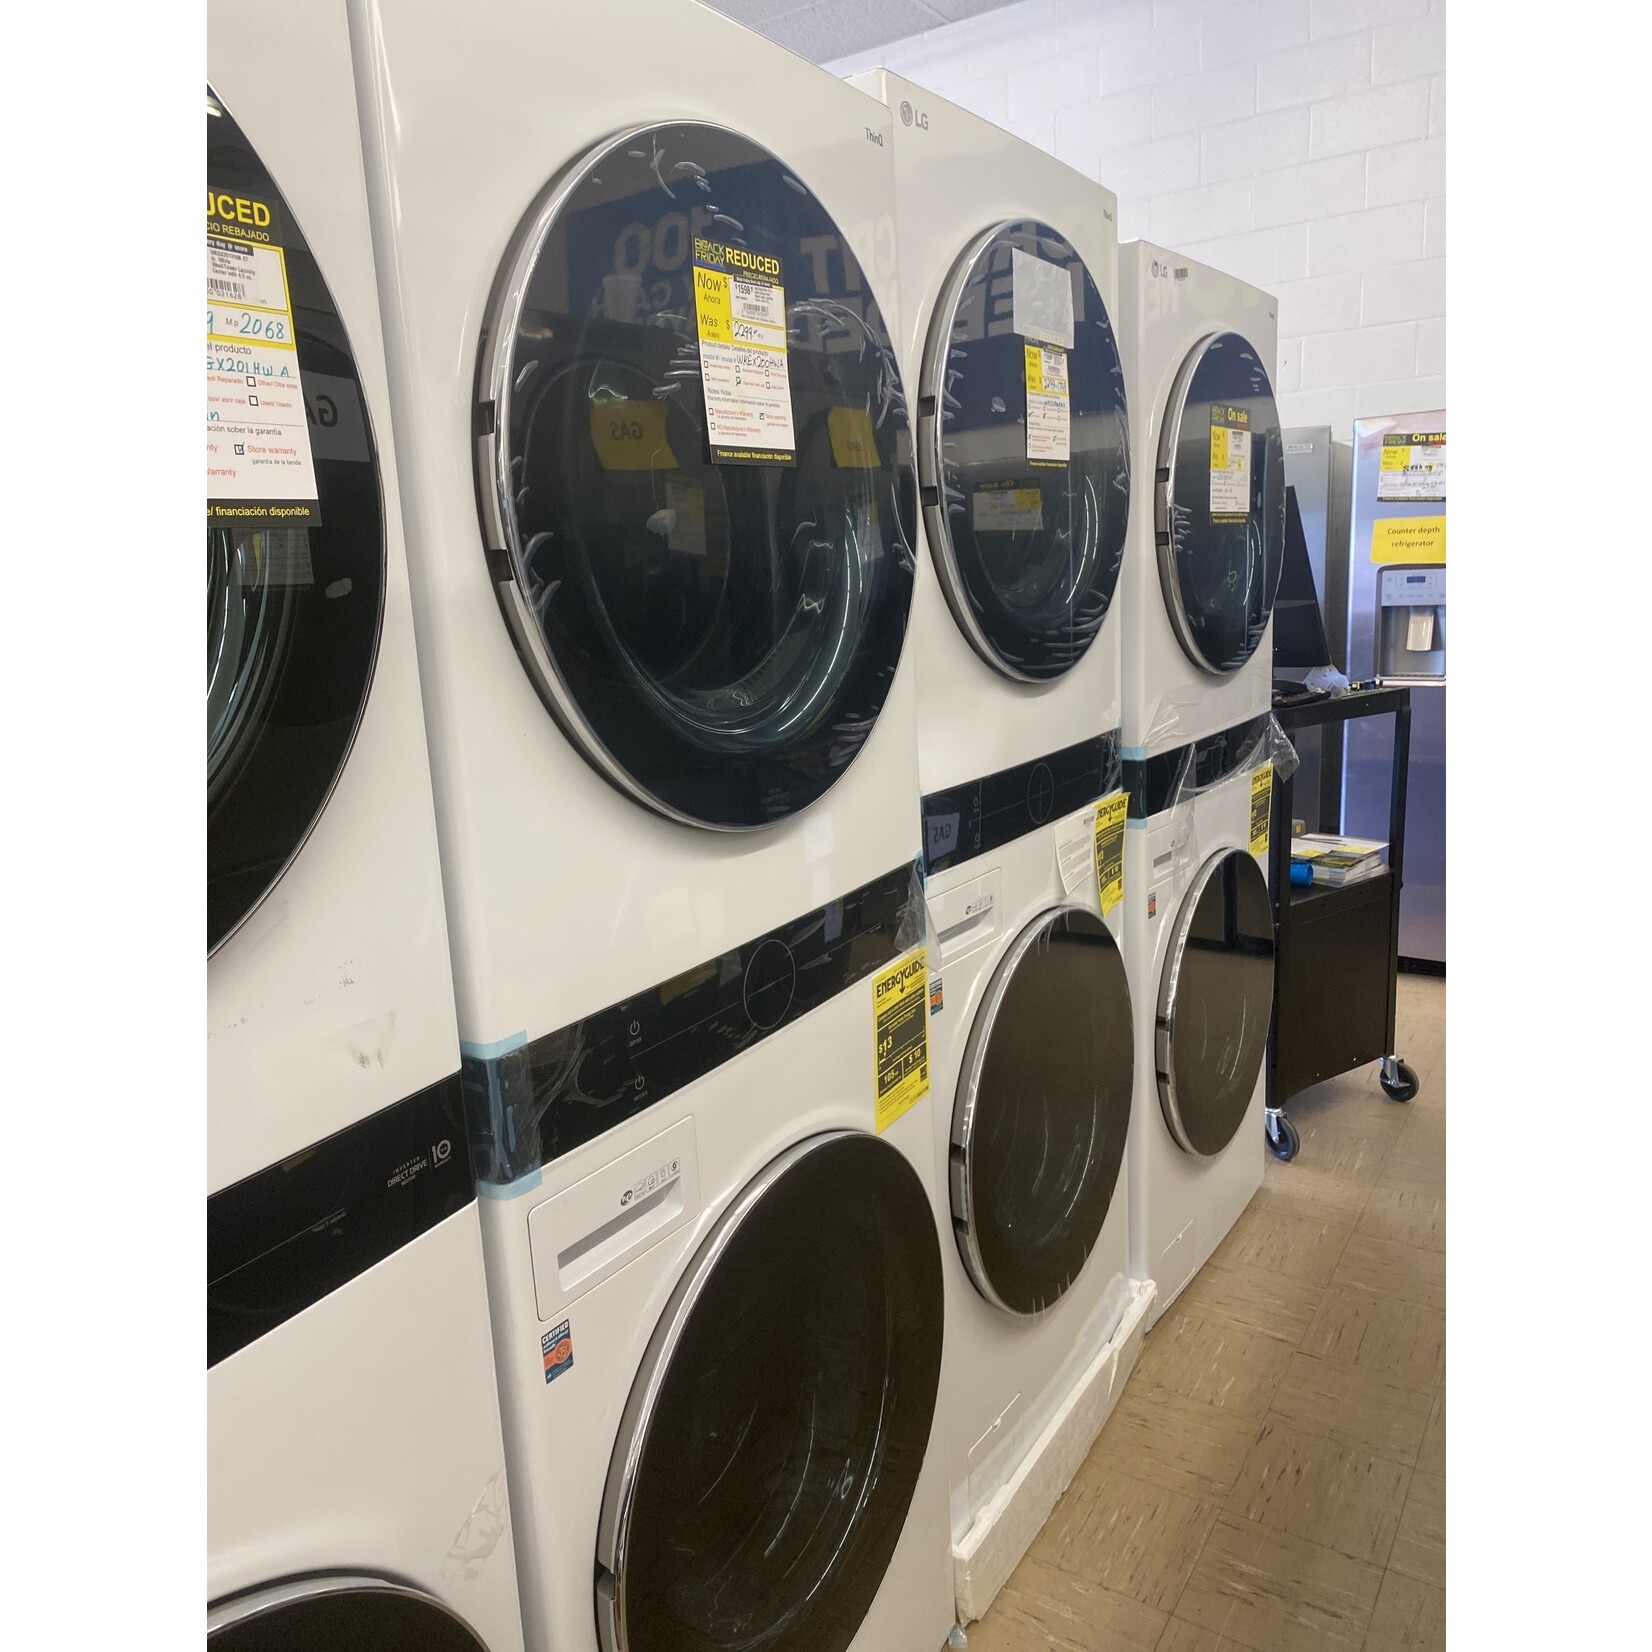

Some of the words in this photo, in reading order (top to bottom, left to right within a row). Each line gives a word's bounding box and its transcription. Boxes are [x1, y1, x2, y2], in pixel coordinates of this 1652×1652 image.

[914, 109, 929, 131] LG
[865, 126, 884, 147] ThinQ
[222, 224, 269, 242] REBAJADO
[725, 247, 780, 275] REDUCED
[237, 267, 255, 276] Laundry
[1159, 266, 1168, 278] LG
[697, 272, 722, 292] Now
[723, 276, 728, 288] $
[703, 293, 721, 304] Ahora
[239, 312, 284, 340] 2068
[700, 313, 718, 328] Was
[725, 319, 731, 331] $
[215, 344, 252, 355] producto
[701, 340, 718, 348] Product
[1227, 407, 1236, 421] On
[1237, 410, 1248, 424] sale
[227, 426, 246, 434] sober
[1412, 434, 1426, 442] On
[247, 445, 267, 454] Store
[268, 447, 297, 456] warranty
[717, 450, 733, 458] Finance
[215, 506, 268, 517] financiación
[269, 506, 310, 518] disponible
[1387, 527, 1416, 535] Counter
[1418, 526, 1440, 535] depth
[1391, 540, 1434, 549] refrigerator
[876, 960, 925, 998] ENERGYGUIDE
[879, 1036, 892, 1053] $13
[884, 1069, 894, 1084] 105
[431, 1139, 451, 1163] 10
[387, 1169, 409, 1188] DIRECT
[409, 1158, 428, 1176] DRIVE
[392, 1156, 421, 1175] INVERTER
[401, 1175, 416, 1186] MOTOR
[542, 1322, 569, 1344] CERTIFIED
